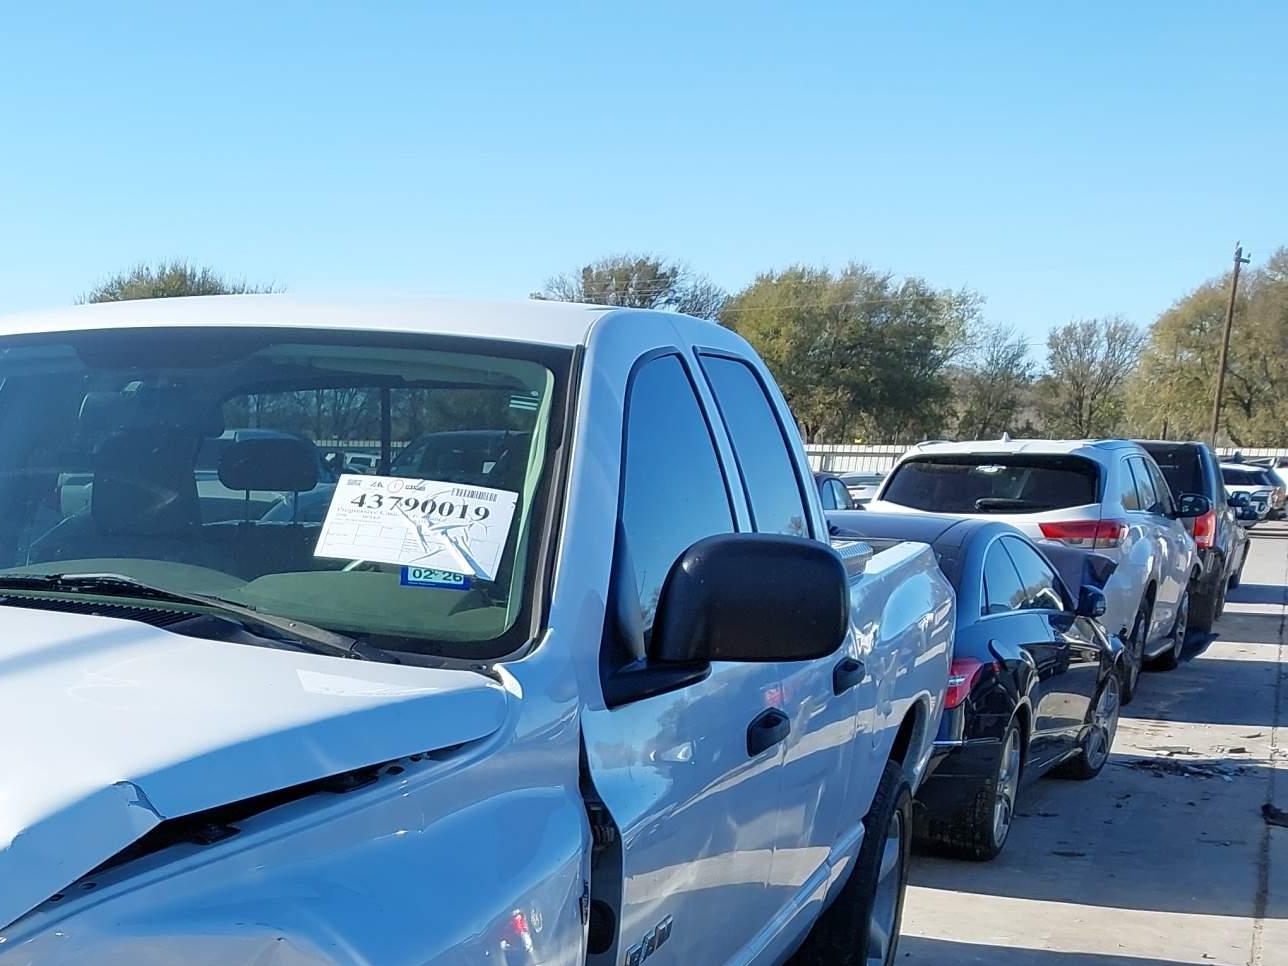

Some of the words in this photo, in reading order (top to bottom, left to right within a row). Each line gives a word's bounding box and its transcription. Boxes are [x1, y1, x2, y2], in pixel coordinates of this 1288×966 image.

[350, 492, 490, 522] 43790019
[412, 568, 433, 580] 02
[442, 570, 463, 583] 26
